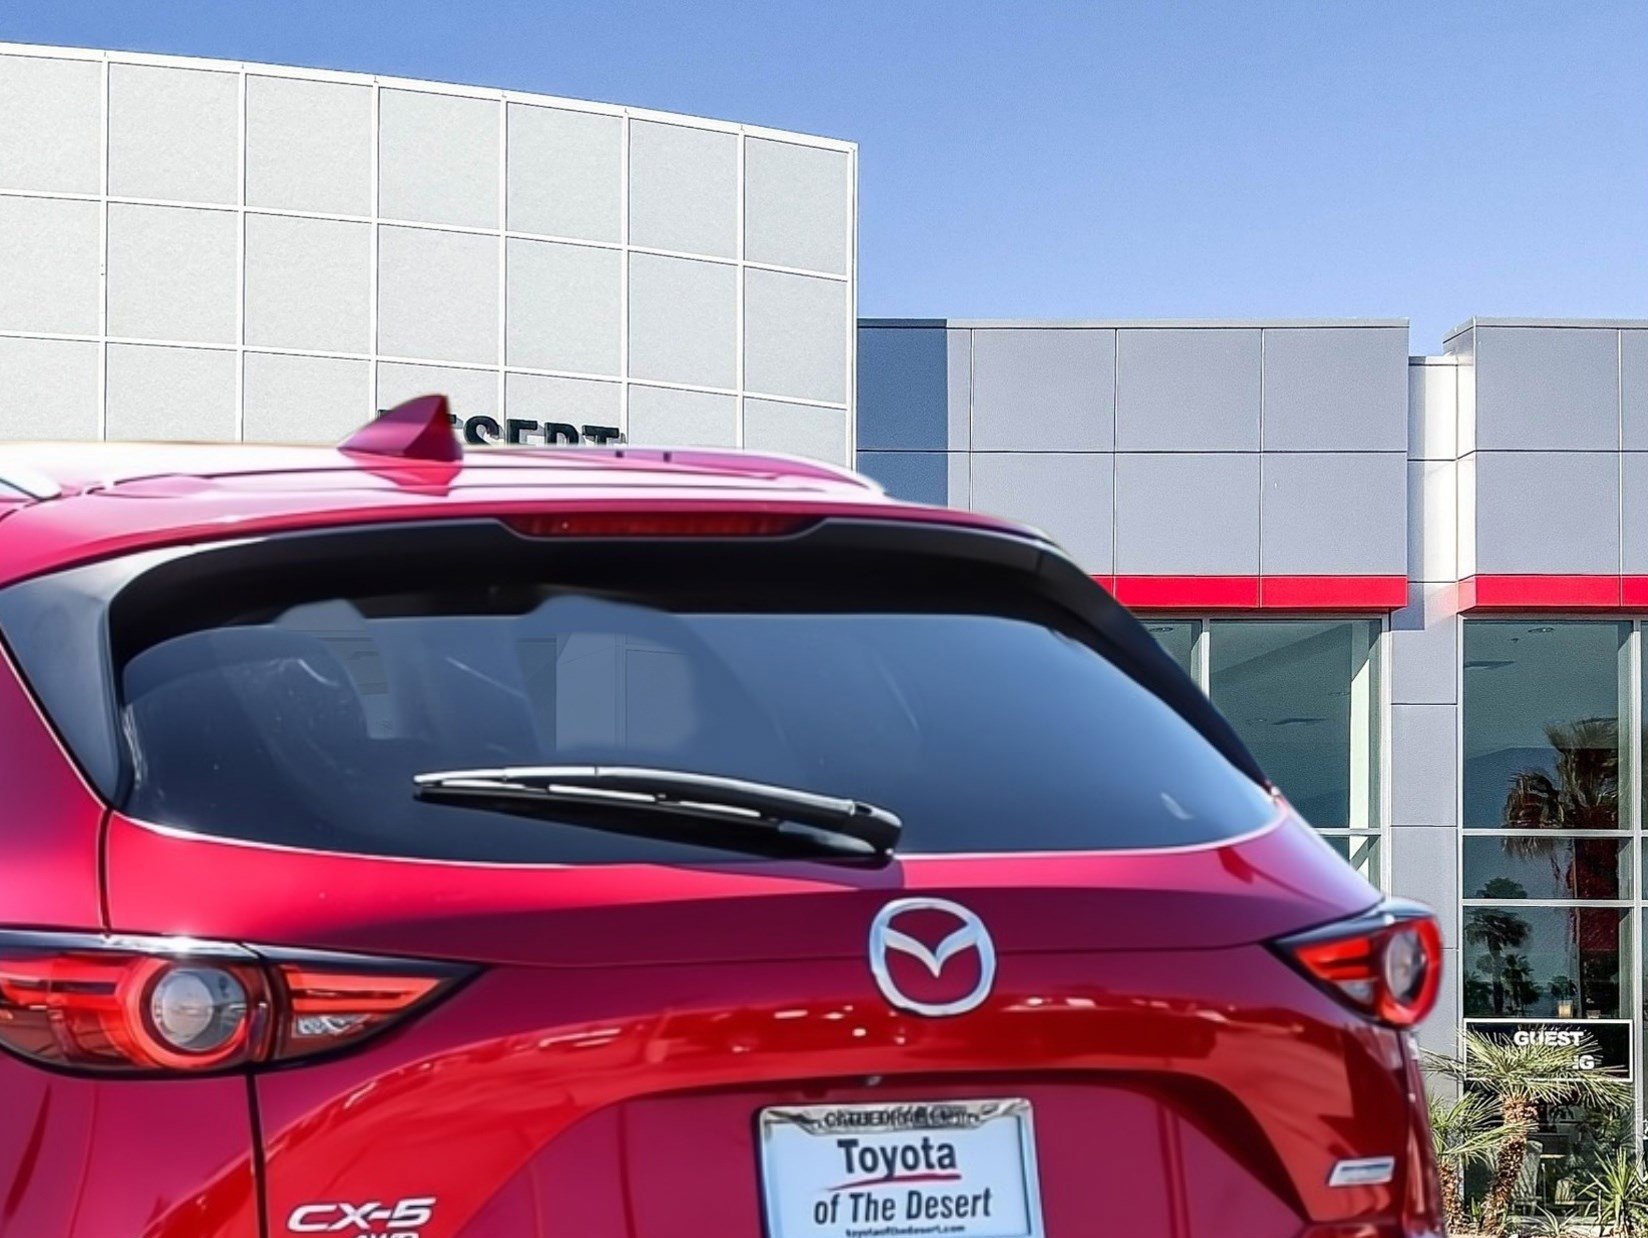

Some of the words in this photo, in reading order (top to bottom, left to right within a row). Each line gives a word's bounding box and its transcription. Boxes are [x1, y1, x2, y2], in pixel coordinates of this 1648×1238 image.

[1514, 1031, 1584, 1046] GUEST
[837, 1137, 957, 1180] Toyota
[287, 1197, 436, 1232] CX-5
[814, 1193, 840, 1225] of
[849, 1190, 896, 1224] The
[906, 1188, 992, 1220] Desert
